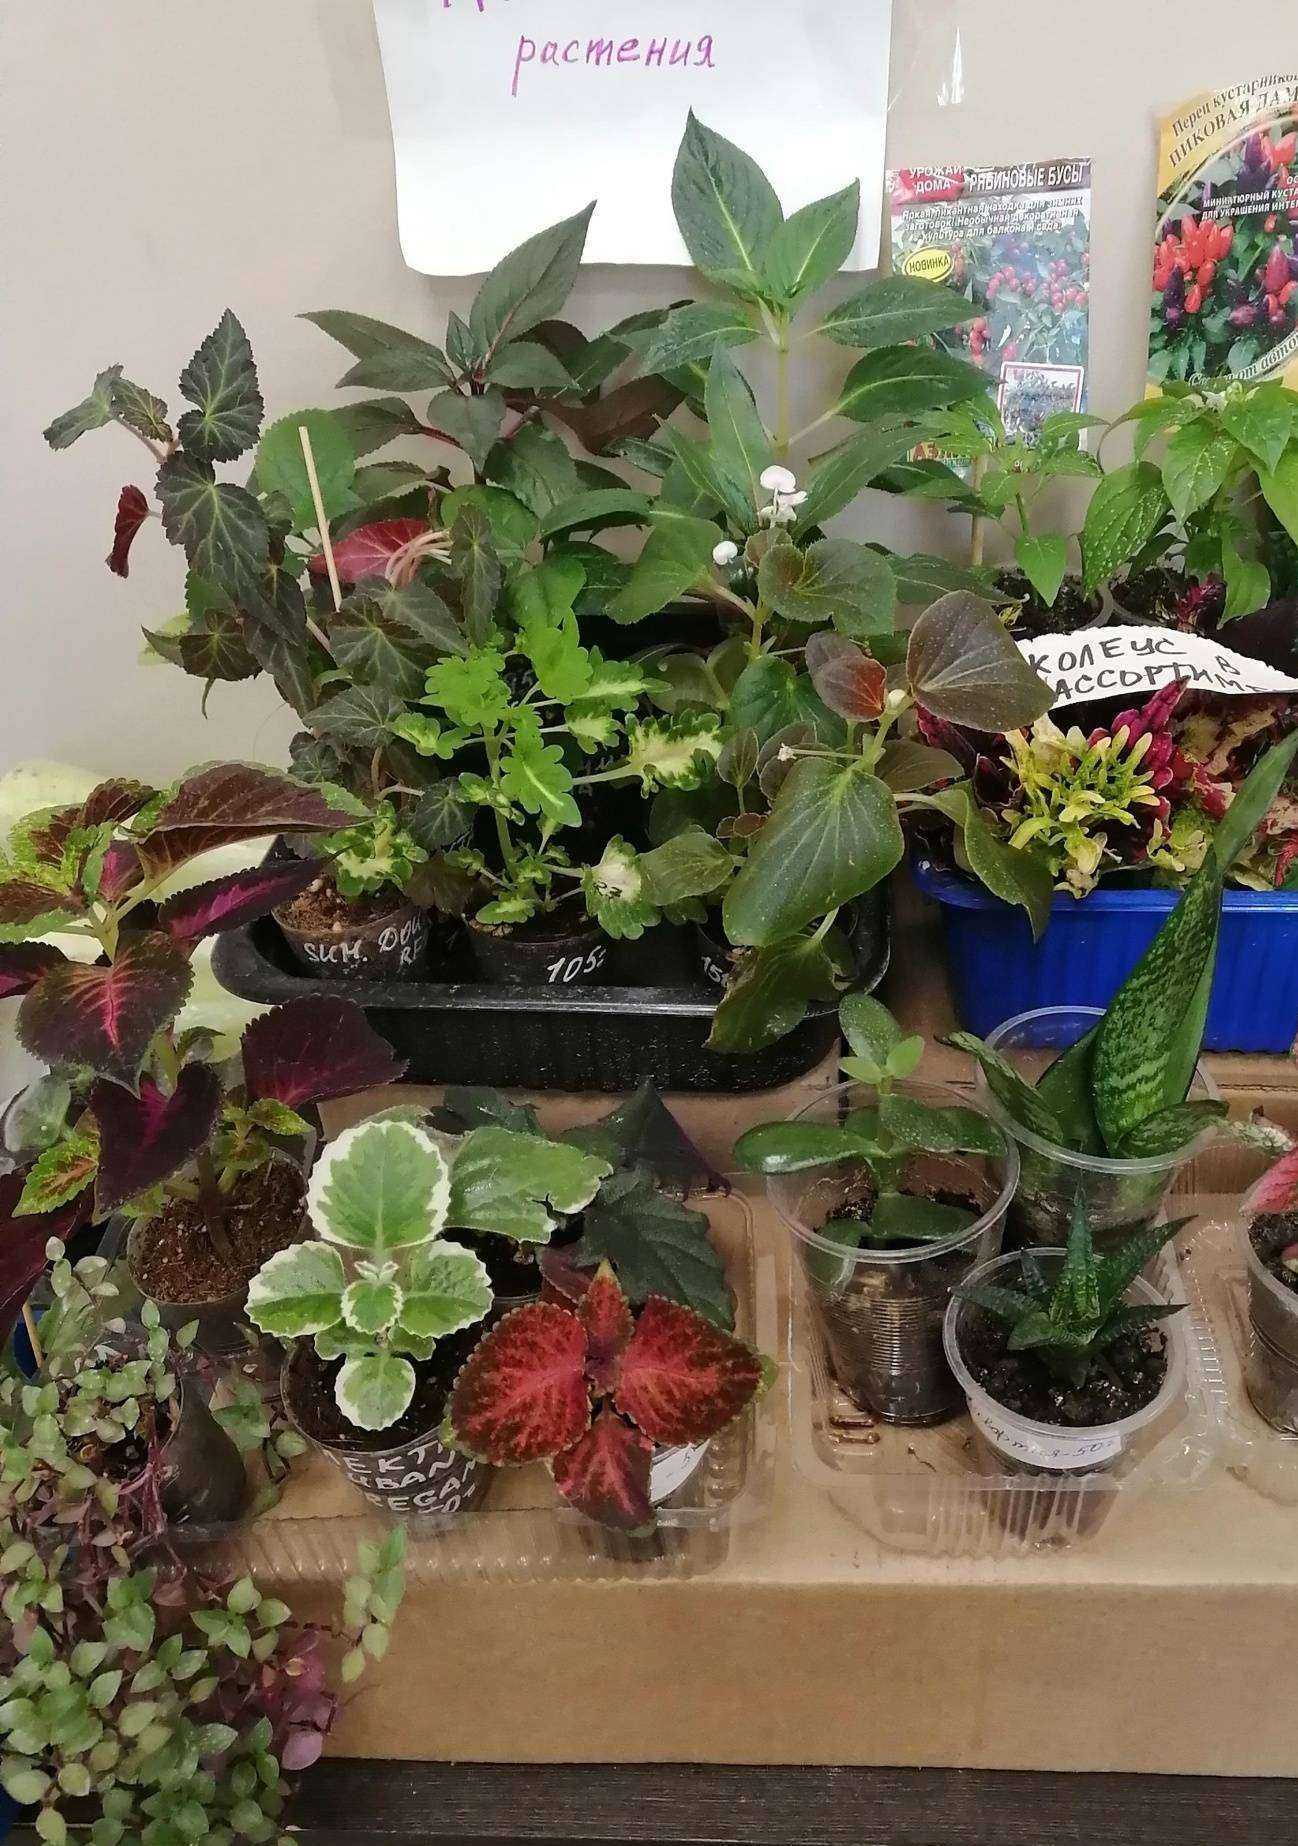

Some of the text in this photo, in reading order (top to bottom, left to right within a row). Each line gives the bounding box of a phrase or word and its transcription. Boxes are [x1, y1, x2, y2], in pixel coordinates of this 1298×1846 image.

[511, 33, 716, 97] растения
[1168, 99, 1250, 169] ПИКОВАЯ
[915, 179, 952, 197] ДОМА
[968, 161, 1086, 193] РЯБИНОВЫЕ БУСЫ
[1219, 202, 1271, 219] УКРАШЕНИЯ
[908, 255, 949, 274] НОВИНКА
[1026, 637, 1187, 674] КОЛЕУС
